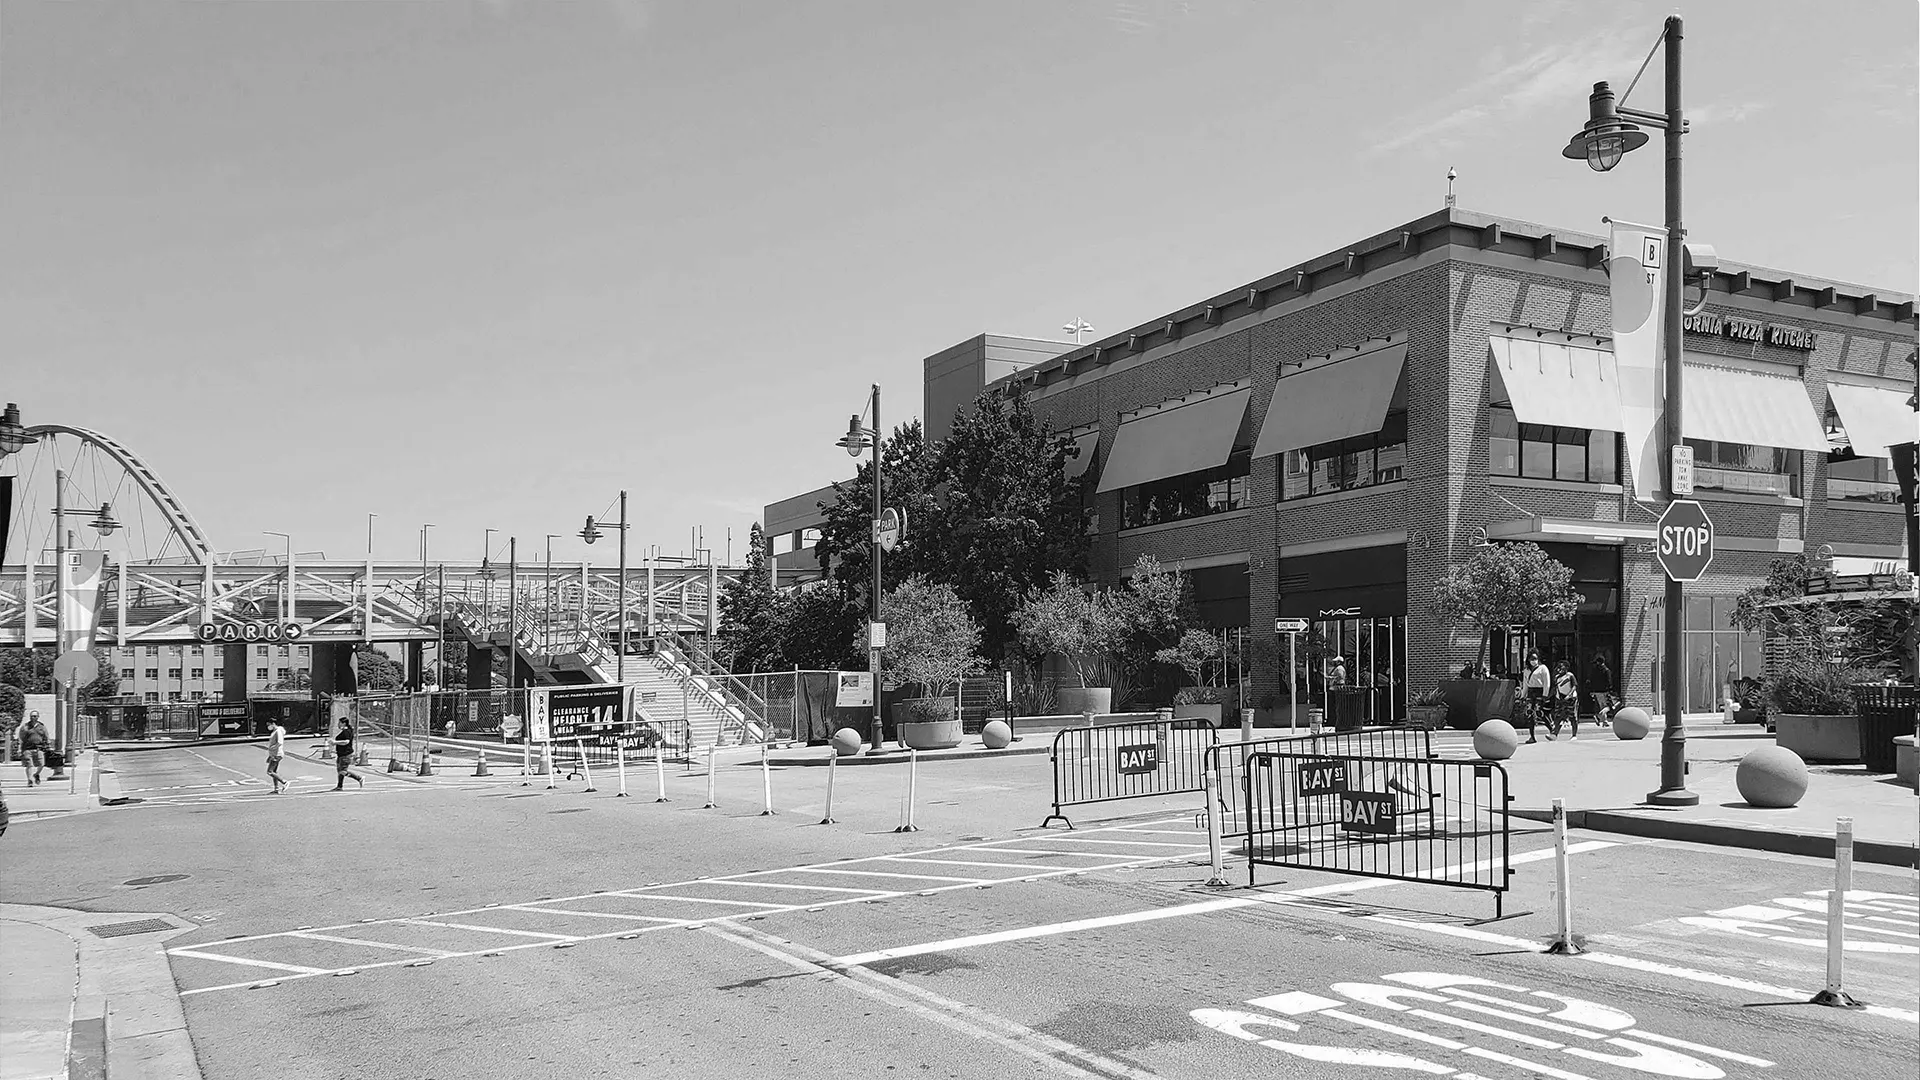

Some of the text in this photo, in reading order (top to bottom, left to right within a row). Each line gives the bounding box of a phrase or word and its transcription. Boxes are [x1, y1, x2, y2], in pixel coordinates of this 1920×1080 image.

[1649, 244, 1655, 261] B
[1646, 273, 1655, 284] ST
[1683, 315, 1818, 349] ORNIA PIZZA KITCHEN
[881, 519, 896, 531] PARK
[1661, 525, 1710, 556] STOP
[1319, 607, 1361, 617] MAC
[203, 625, 278, 638] PARK
[201, 708, 219, 716] PARKING
[223, 707, 245, 715] DELIVERIES
[553, 707, 589, 716] CLEARANCE
[553, 714, 589, 727] HEIGHT
[599, 736, 614, 745] BAY
[622, 737, 638, 748] BAY
[1120, 749, 1155, 769] BAY ST
[1302, 766, 1344, 790] BAY ST
[1343, 799, 1392, 825] BAY ST
